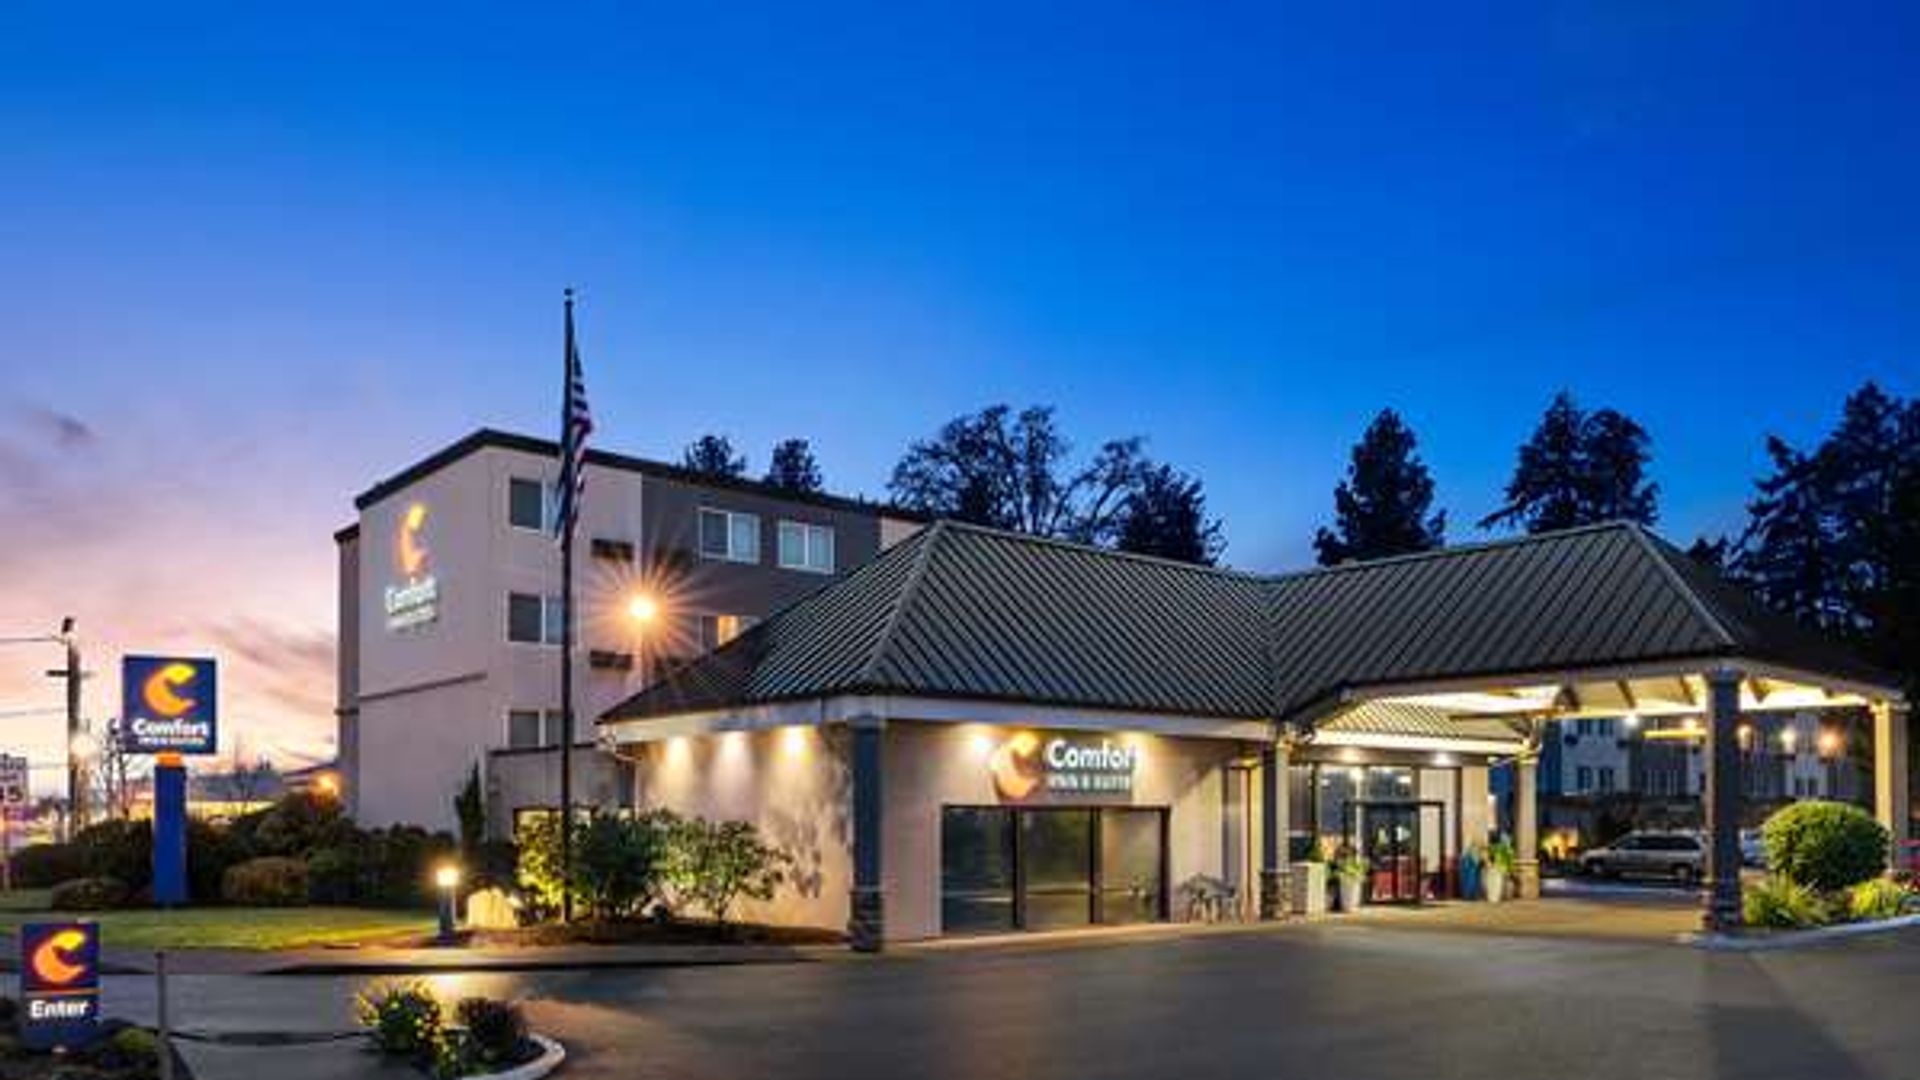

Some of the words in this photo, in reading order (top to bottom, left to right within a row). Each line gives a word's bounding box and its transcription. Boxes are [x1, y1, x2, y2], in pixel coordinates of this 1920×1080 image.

[131, 718, 209, 736] Comfort
[1093, 774, 1132, 791] SUITE
[30, 1000, 89, 1019] Enter
